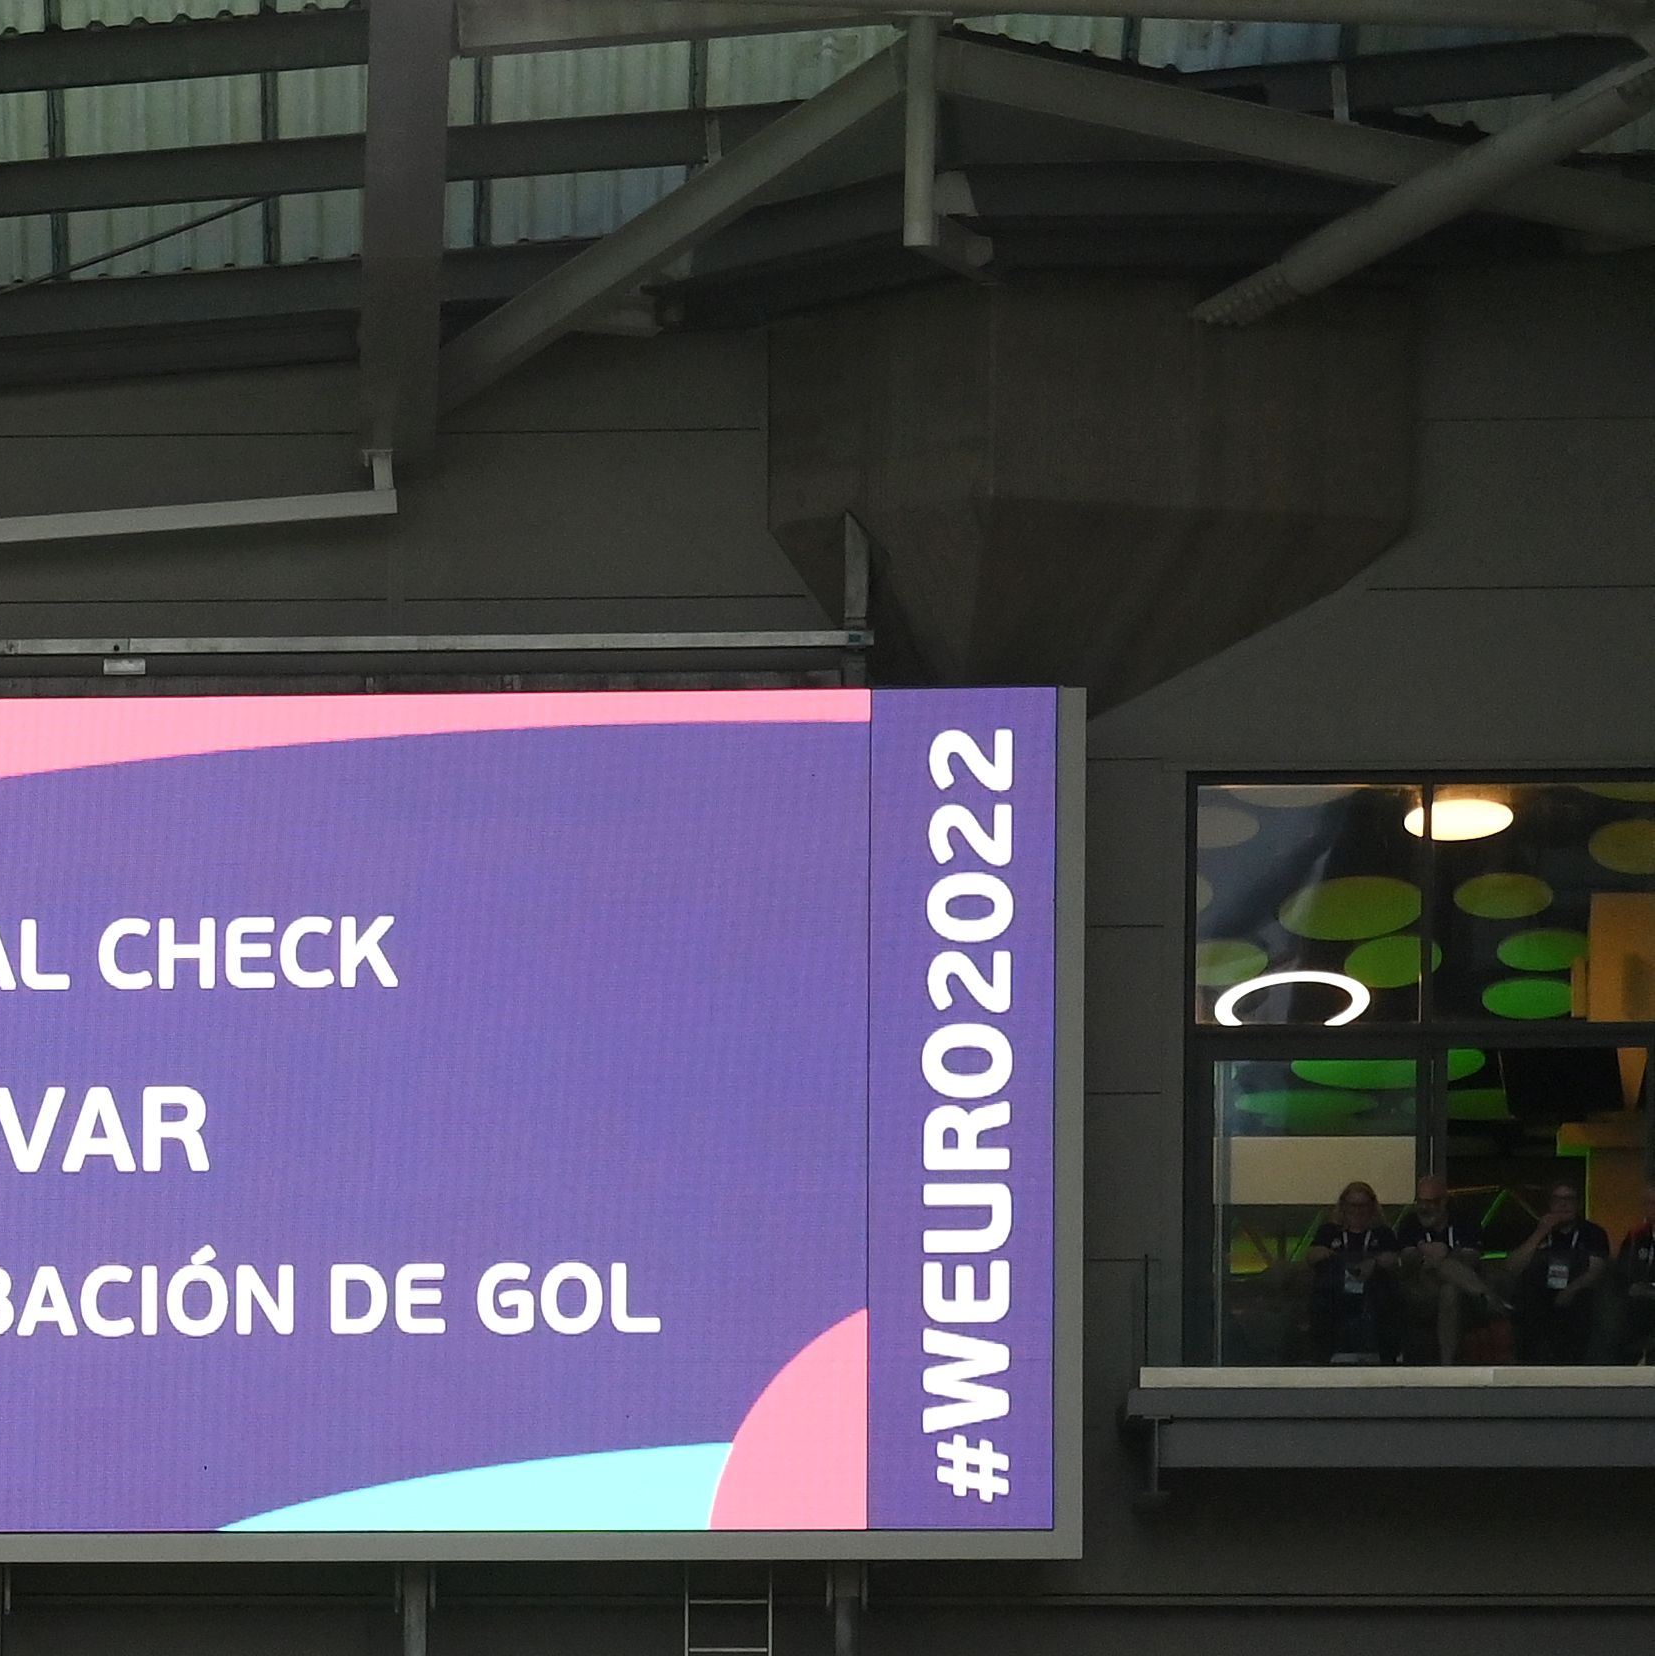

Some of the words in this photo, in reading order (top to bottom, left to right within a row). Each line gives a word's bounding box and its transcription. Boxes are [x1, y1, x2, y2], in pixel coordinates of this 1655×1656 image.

[98, 916, 399, 991] CHECK
[921, 727, 1014, 1503] #WEURO2022
[330, 1263, 446, 1334] DE
[477, 1261, 662, 1335] GOL
